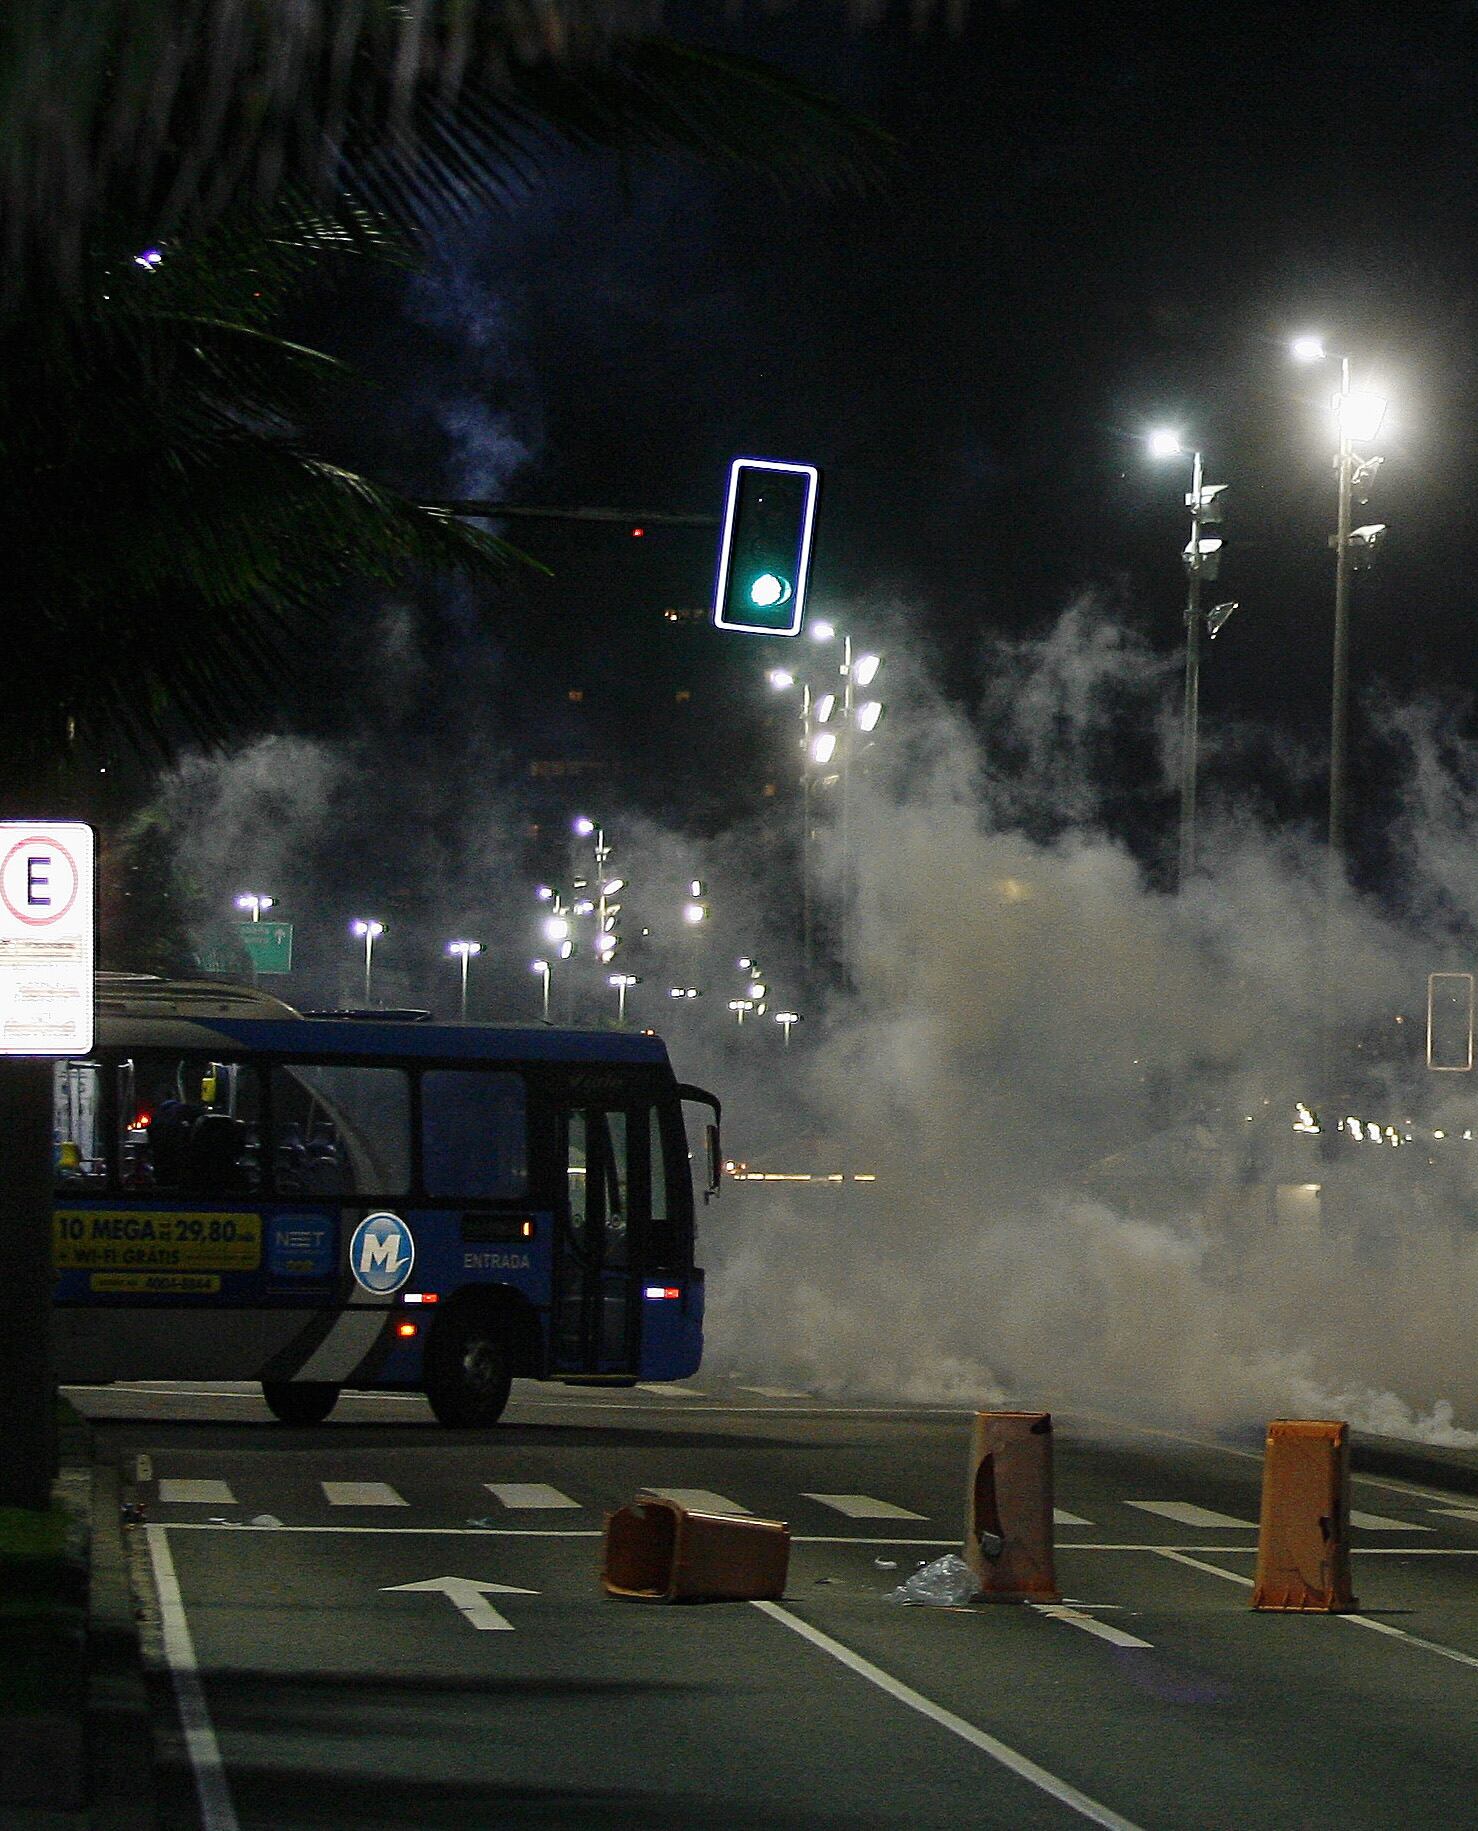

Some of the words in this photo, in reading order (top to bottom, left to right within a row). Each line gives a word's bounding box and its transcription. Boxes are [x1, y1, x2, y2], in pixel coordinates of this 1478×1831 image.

[27, 857, 51, 905] E
[59, 1218, 83, 1240] 10
[92, 1218, 156, 1240] MEGA
[276, 1231, 326, 1247] NET
[359, 1233, 411, 1273] M
[463, 1253, 530, 1269] ENTRADA
